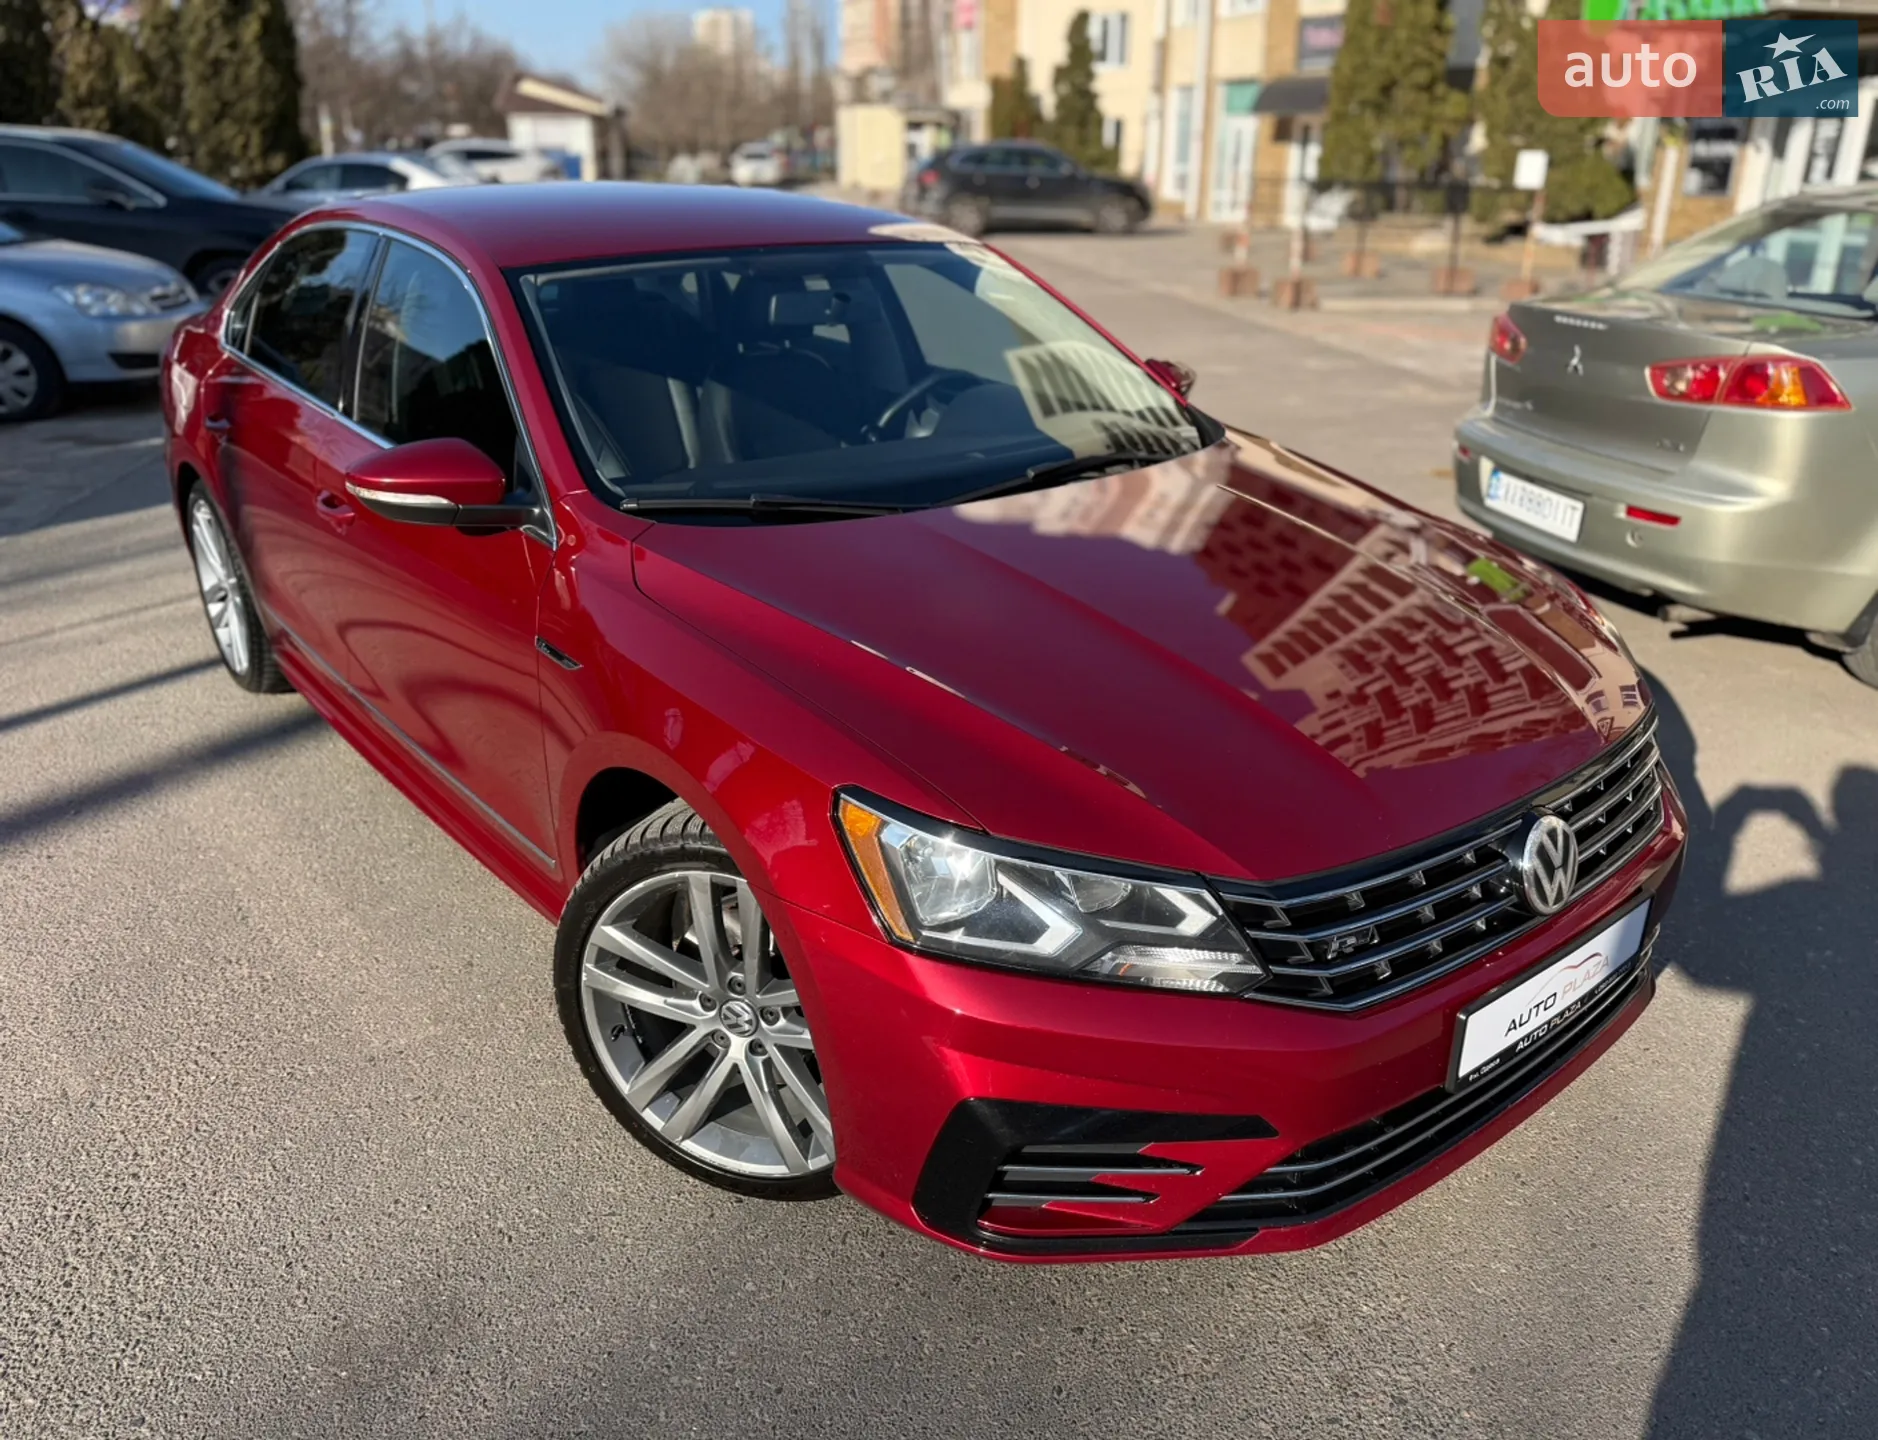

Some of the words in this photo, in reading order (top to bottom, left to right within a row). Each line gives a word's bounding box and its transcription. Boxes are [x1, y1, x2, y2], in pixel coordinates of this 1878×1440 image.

[1504, 991, 1557, 1037] AUTO
[1561, 955, 1609, 1000] PLAZA
[1515, 1024, 1548, 1052] AUTO
[1549, 1001, 1582, 1029] PLAZA
